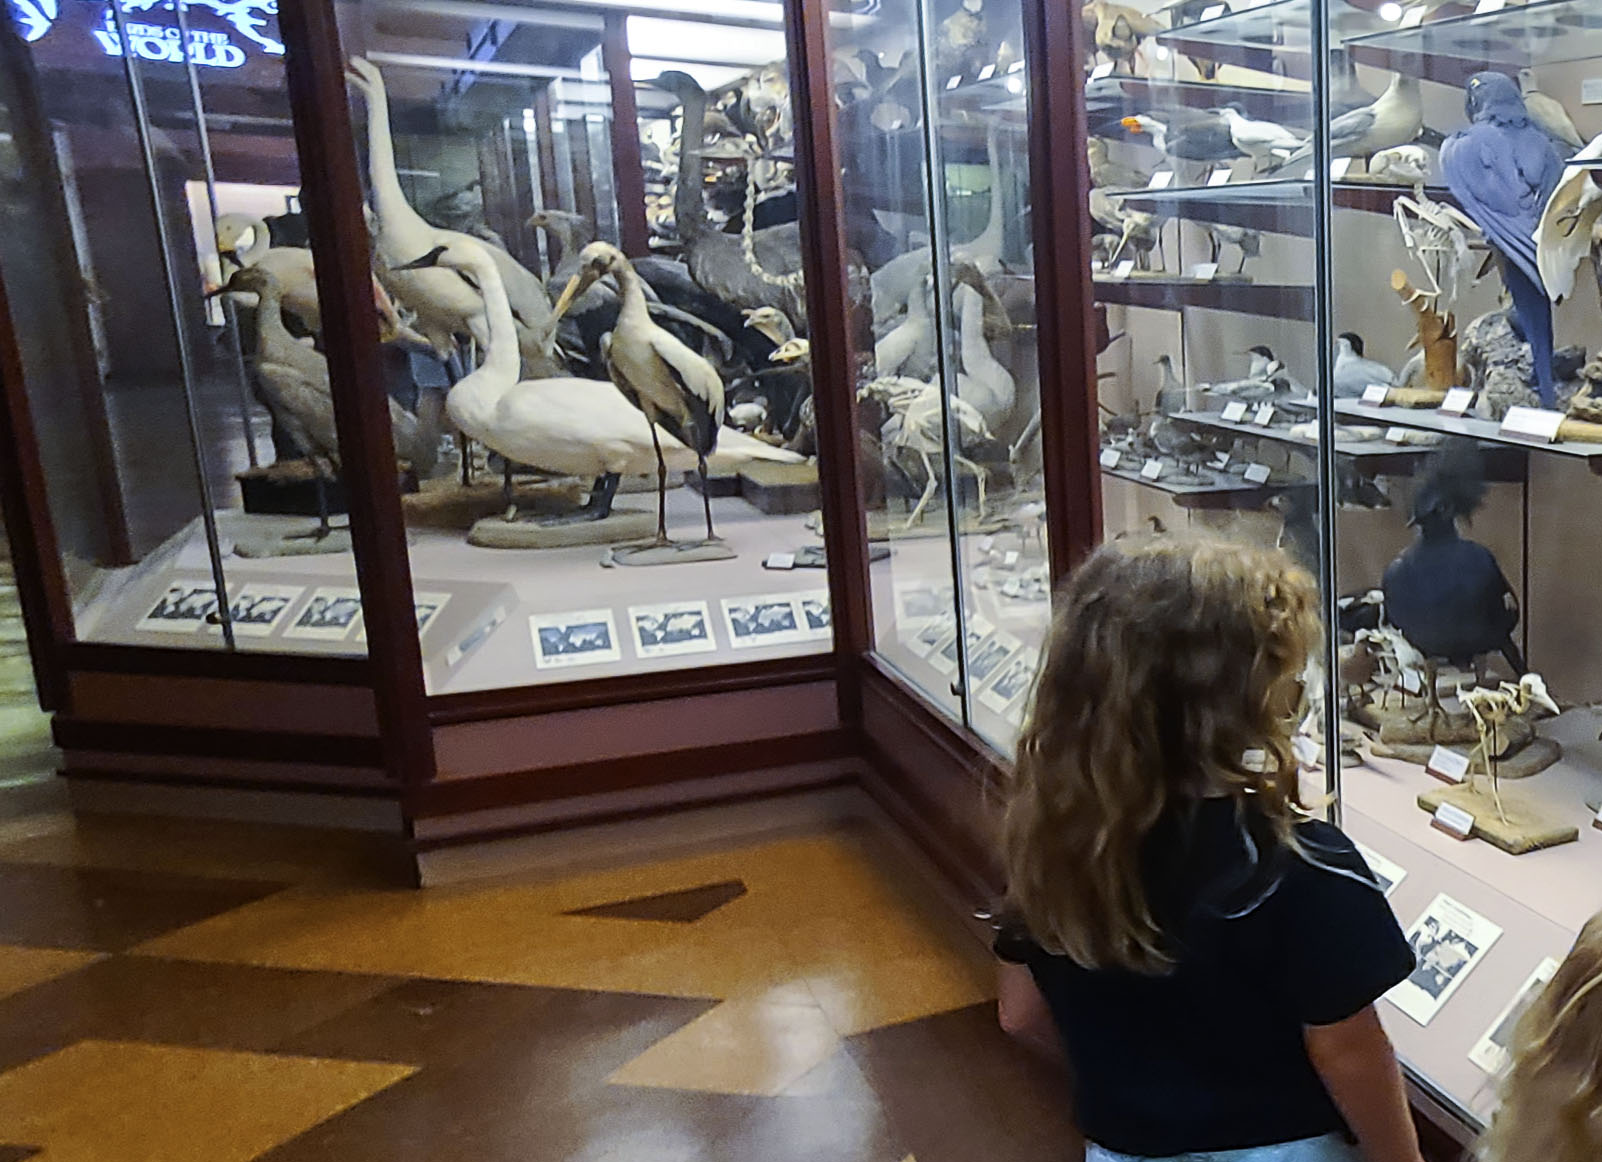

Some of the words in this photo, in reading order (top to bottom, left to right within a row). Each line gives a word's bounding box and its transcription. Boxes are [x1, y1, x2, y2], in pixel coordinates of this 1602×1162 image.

[105, 20, 164, 38] BRDS
[191, 30, 229, 45] THE
[93, 30, 245, 67] WORLD
